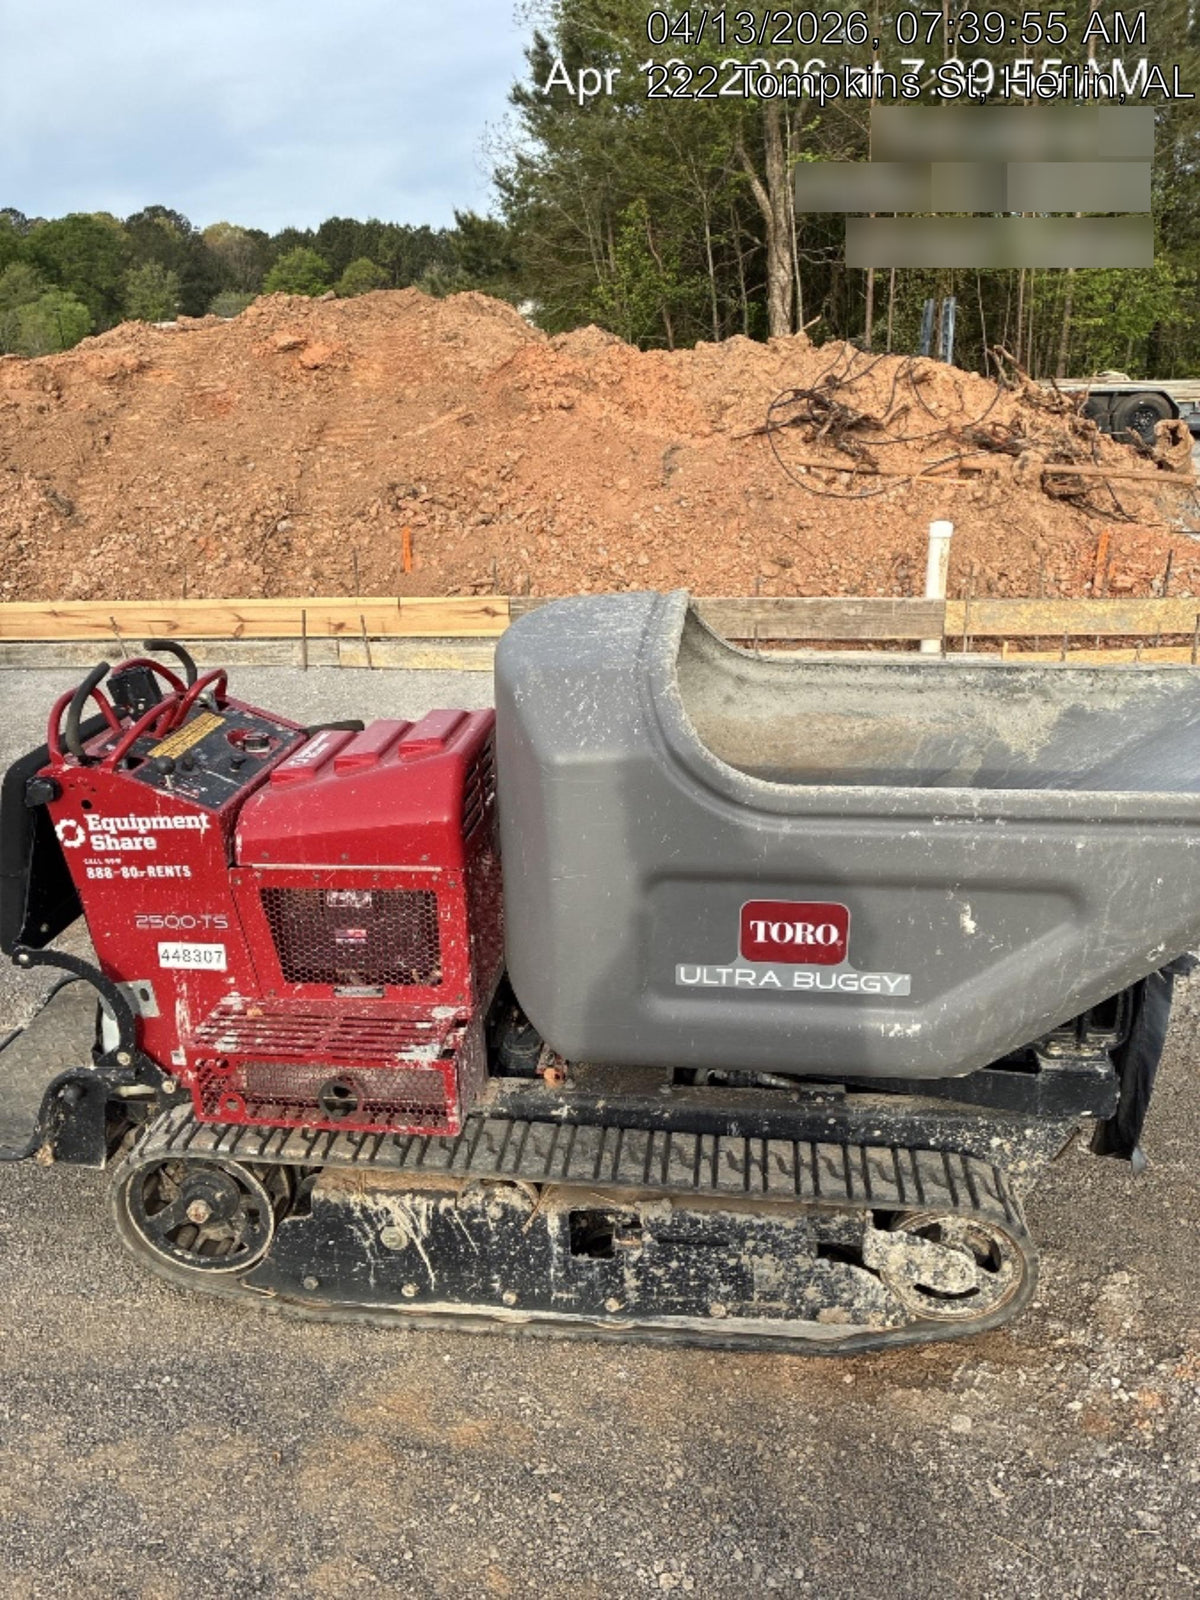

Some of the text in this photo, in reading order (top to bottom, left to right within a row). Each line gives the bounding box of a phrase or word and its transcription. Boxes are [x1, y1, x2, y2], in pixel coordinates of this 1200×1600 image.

[84, 813, 211, 834] Equipment
[90, 834, 157, 851] Share
[135, 914, 229, 929] 2500-TS
[749, 920, 840, 946] TORO
[161, 948, 223, 964] 448307
[679, 966, 905, 993] ULTRA BUGGY
